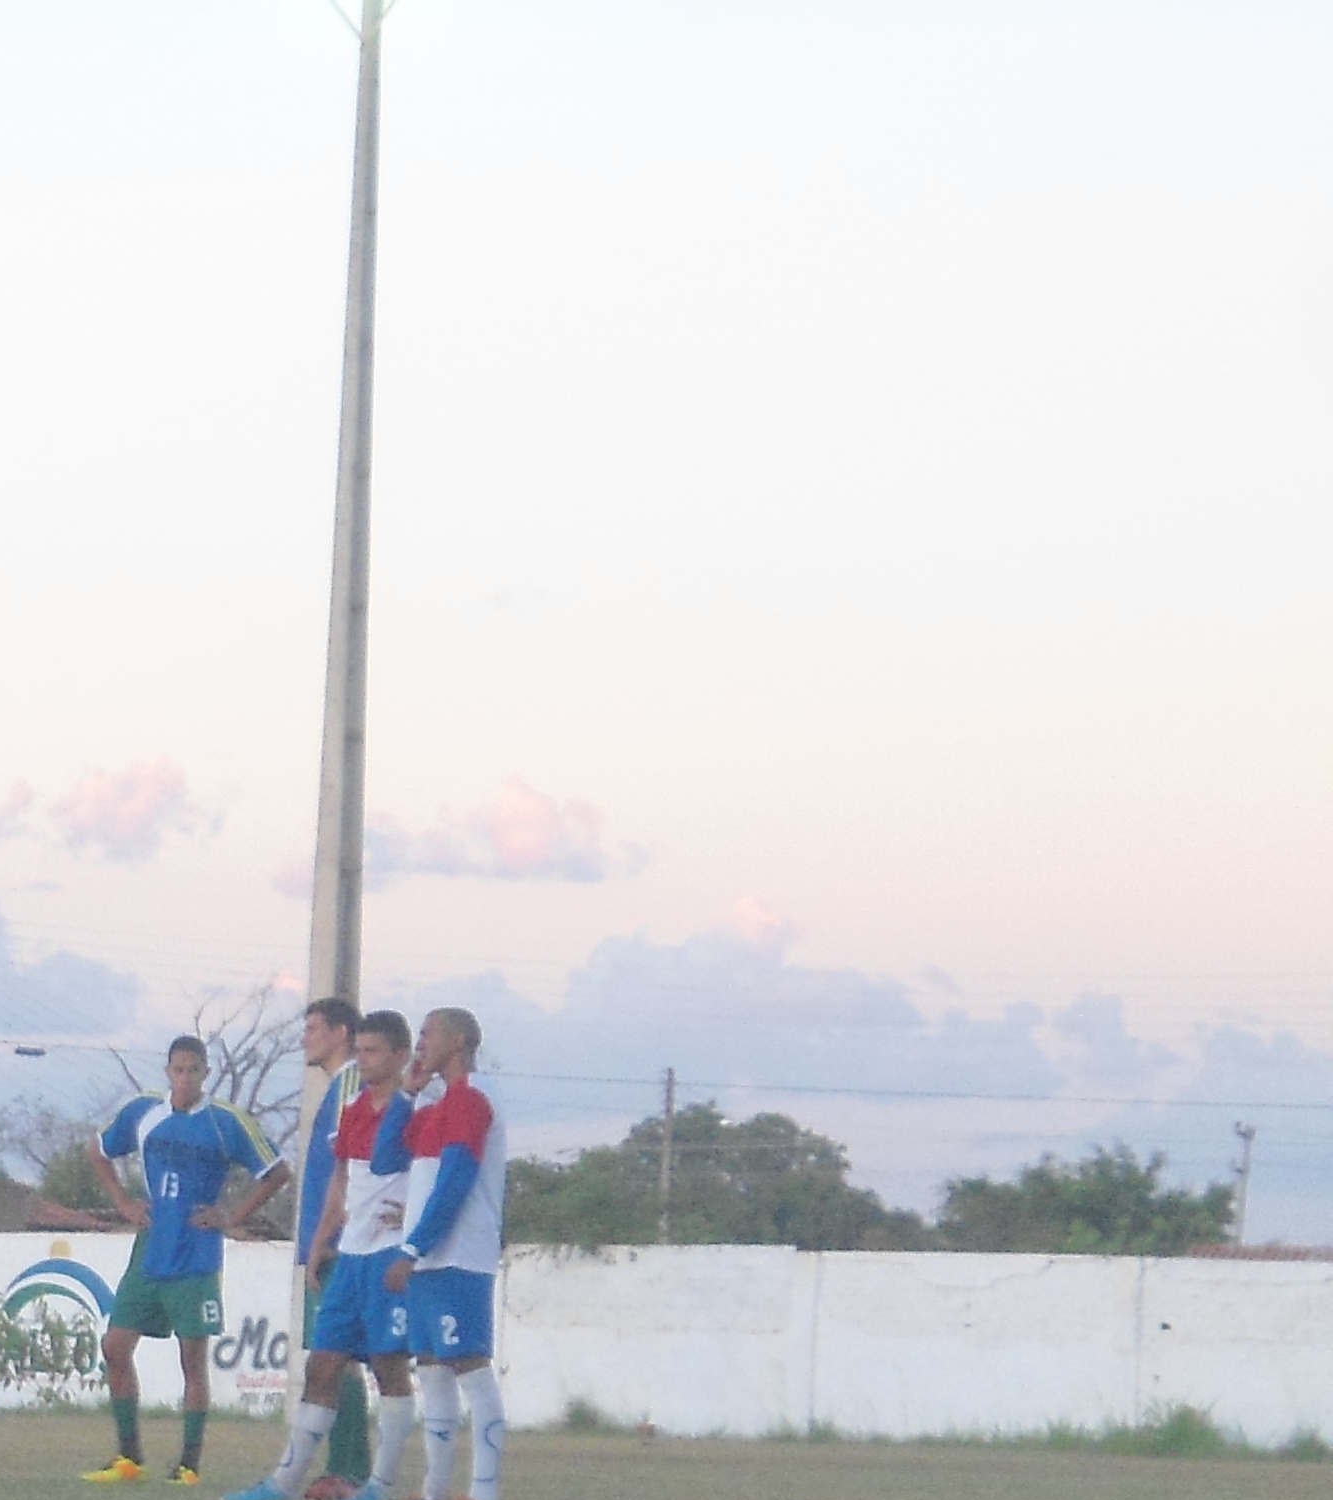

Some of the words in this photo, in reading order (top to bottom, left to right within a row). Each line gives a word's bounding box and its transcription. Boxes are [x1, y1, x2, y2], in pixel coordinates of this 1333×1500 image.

[161, 1171, 179, 1198] 13
[202, 1299, 220, 1324] 13
[391, 1306, 408, 1336] 3
[440, 1315, 460, 1346] 2
